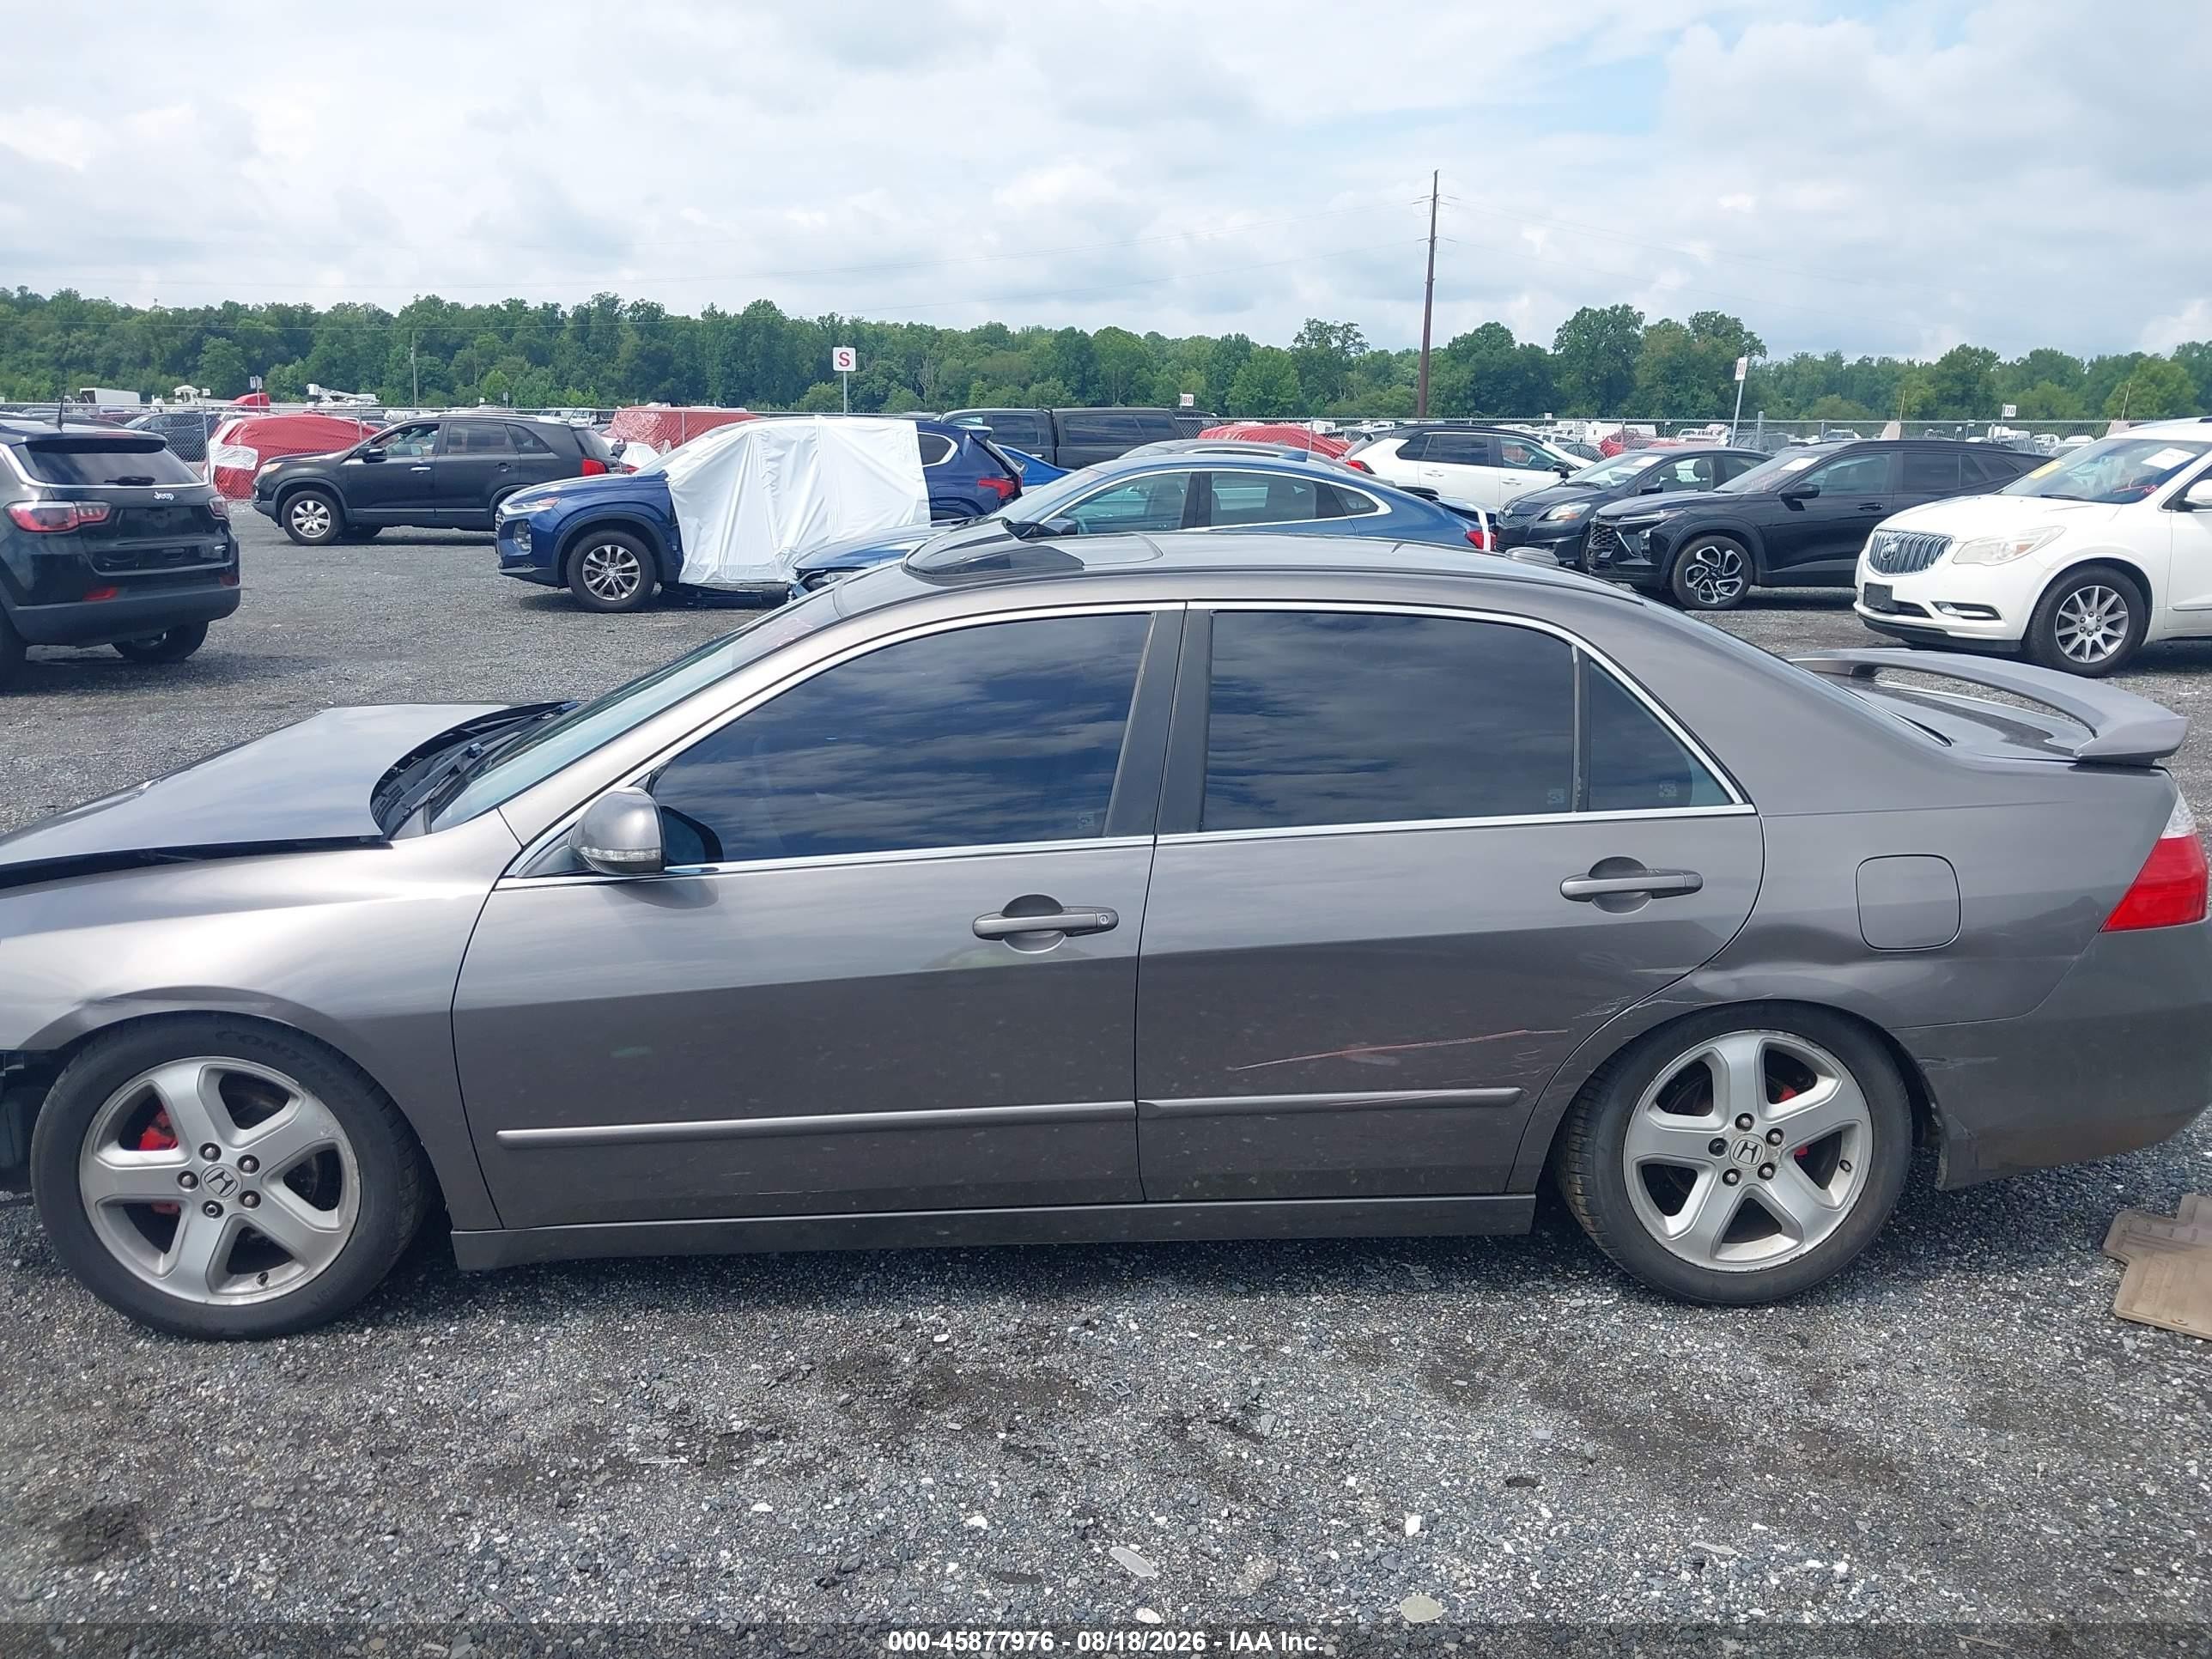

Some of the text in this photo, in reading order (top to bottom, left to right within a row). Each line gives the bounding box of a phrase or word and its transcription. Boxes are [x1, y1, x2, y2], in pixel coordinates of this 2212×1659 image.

[838, 351, 851, 368] S
[1736, 362, 1746, 375] 80
[2006, 406, 2015, 415] 70
[154, 491, 174, 501] Jeep
